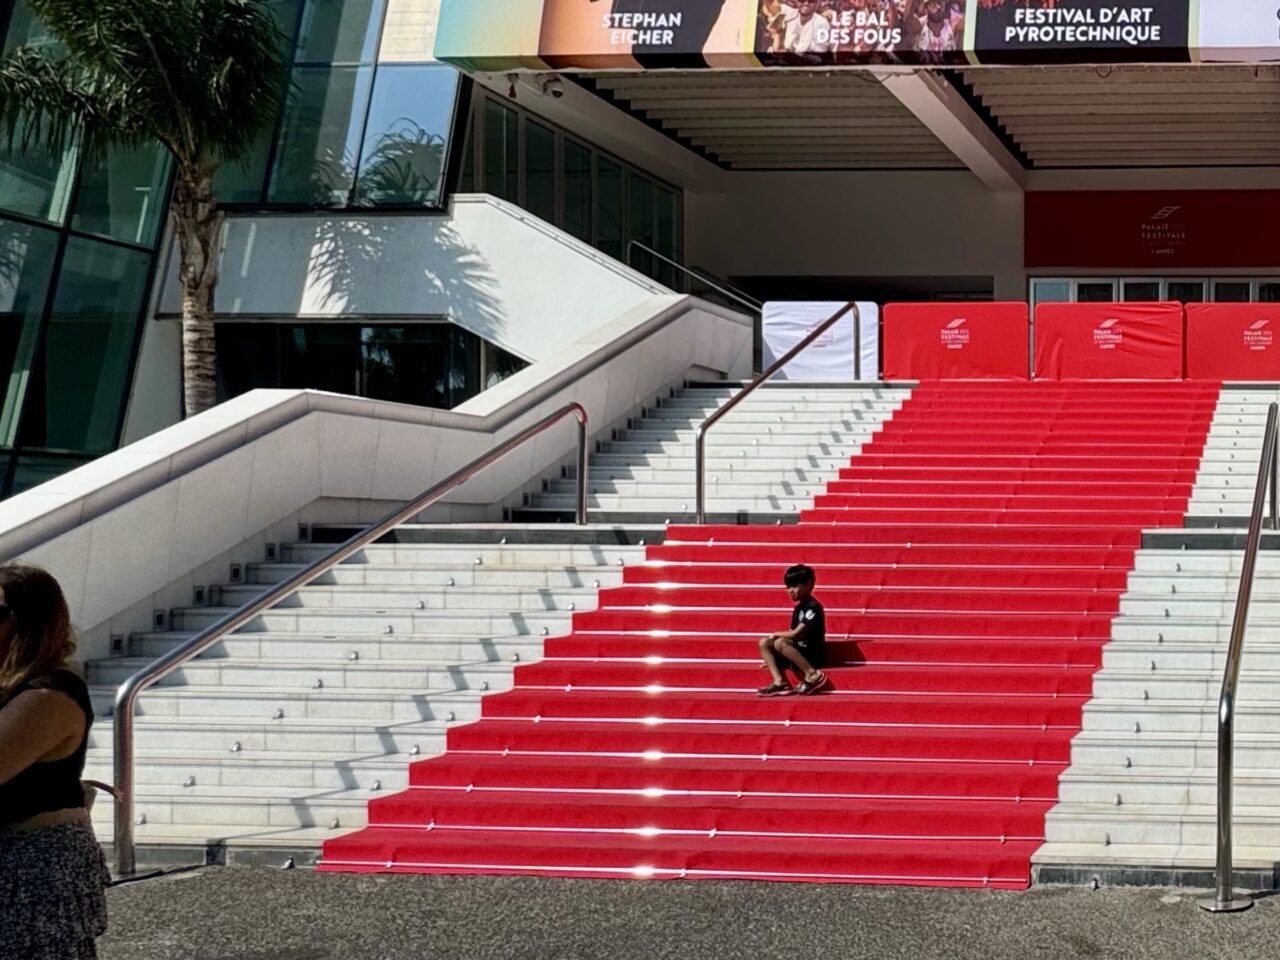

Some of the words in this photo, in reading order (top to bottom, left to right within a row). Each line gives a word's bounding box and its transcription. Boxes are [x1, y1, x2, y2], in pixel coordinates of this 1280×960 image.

[601, 12, 682, 29] STEPHAN
[832, 11, 852, 28] LE
[856, 10, 889, 27] BAL
[1015, 9, 1095, 24] FESTIVAL
[1099, 7, 1153, 24] D'ART
[610, 29, 674, 45] EICHER
[817, 28, 851, 45] DES
[854, 28, 902, 45] FOUS
[1005, 26, 1161, 45] PYROTECHNIQUE
